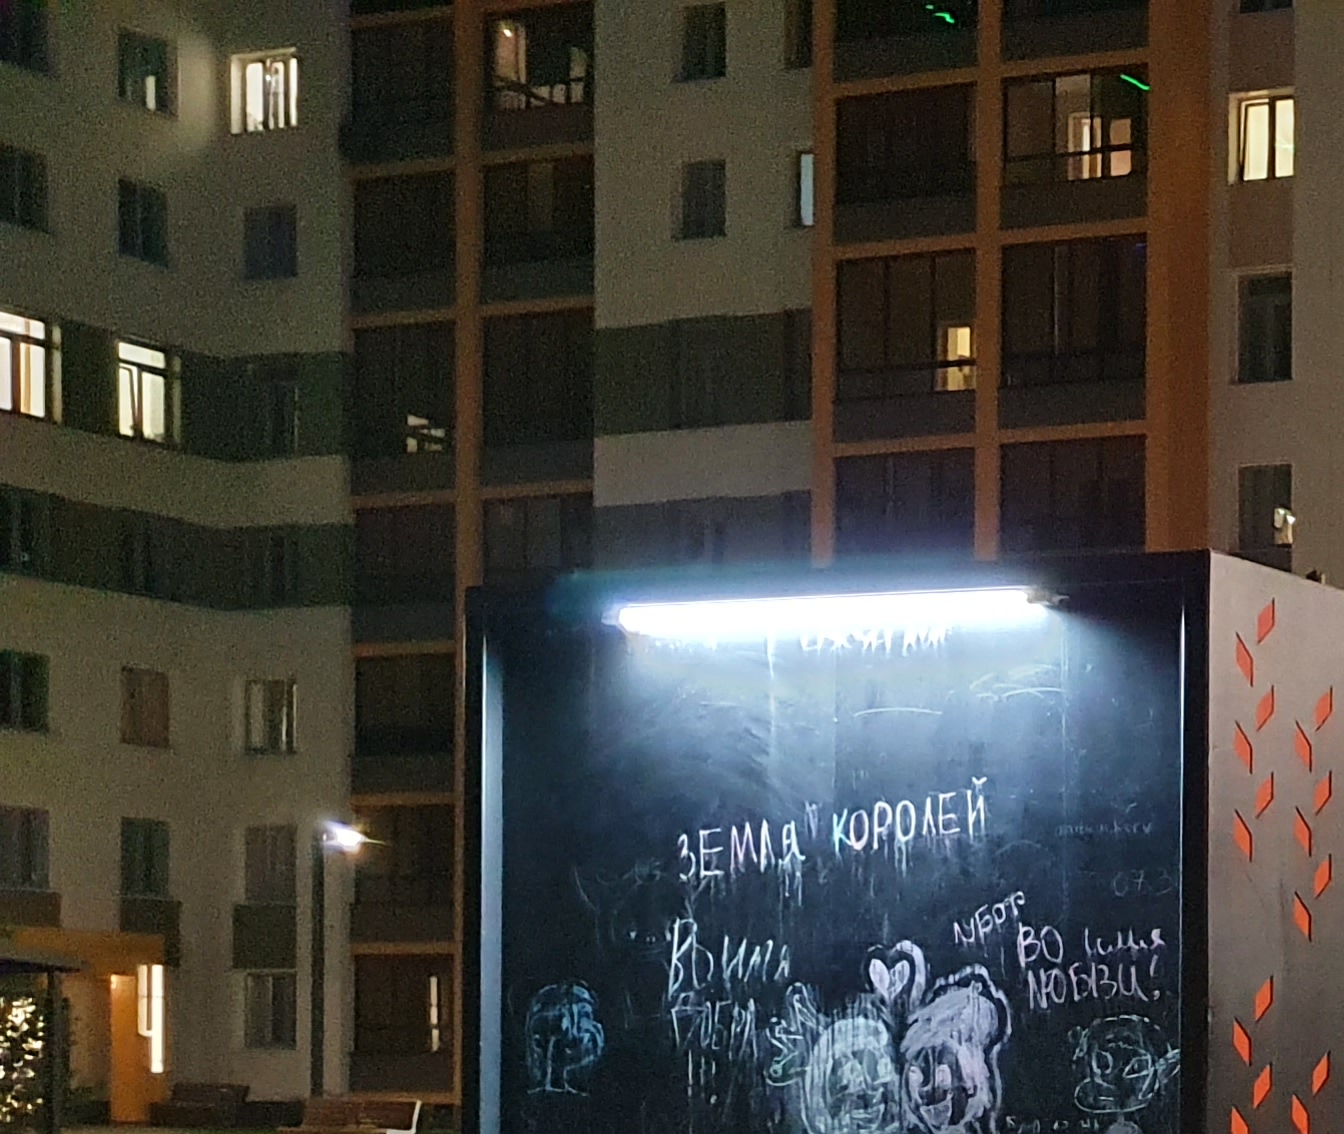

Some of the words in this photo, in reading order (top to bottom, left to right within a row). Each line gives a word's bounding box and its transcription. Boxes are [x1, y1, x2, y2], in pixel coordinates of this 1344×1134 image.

[677, 820, 806, 881] ЗЕМЛЯ
[832, 775, 989, 853] КОРОЛЕЙ
[1017, 921, 1064, 968] ВО
